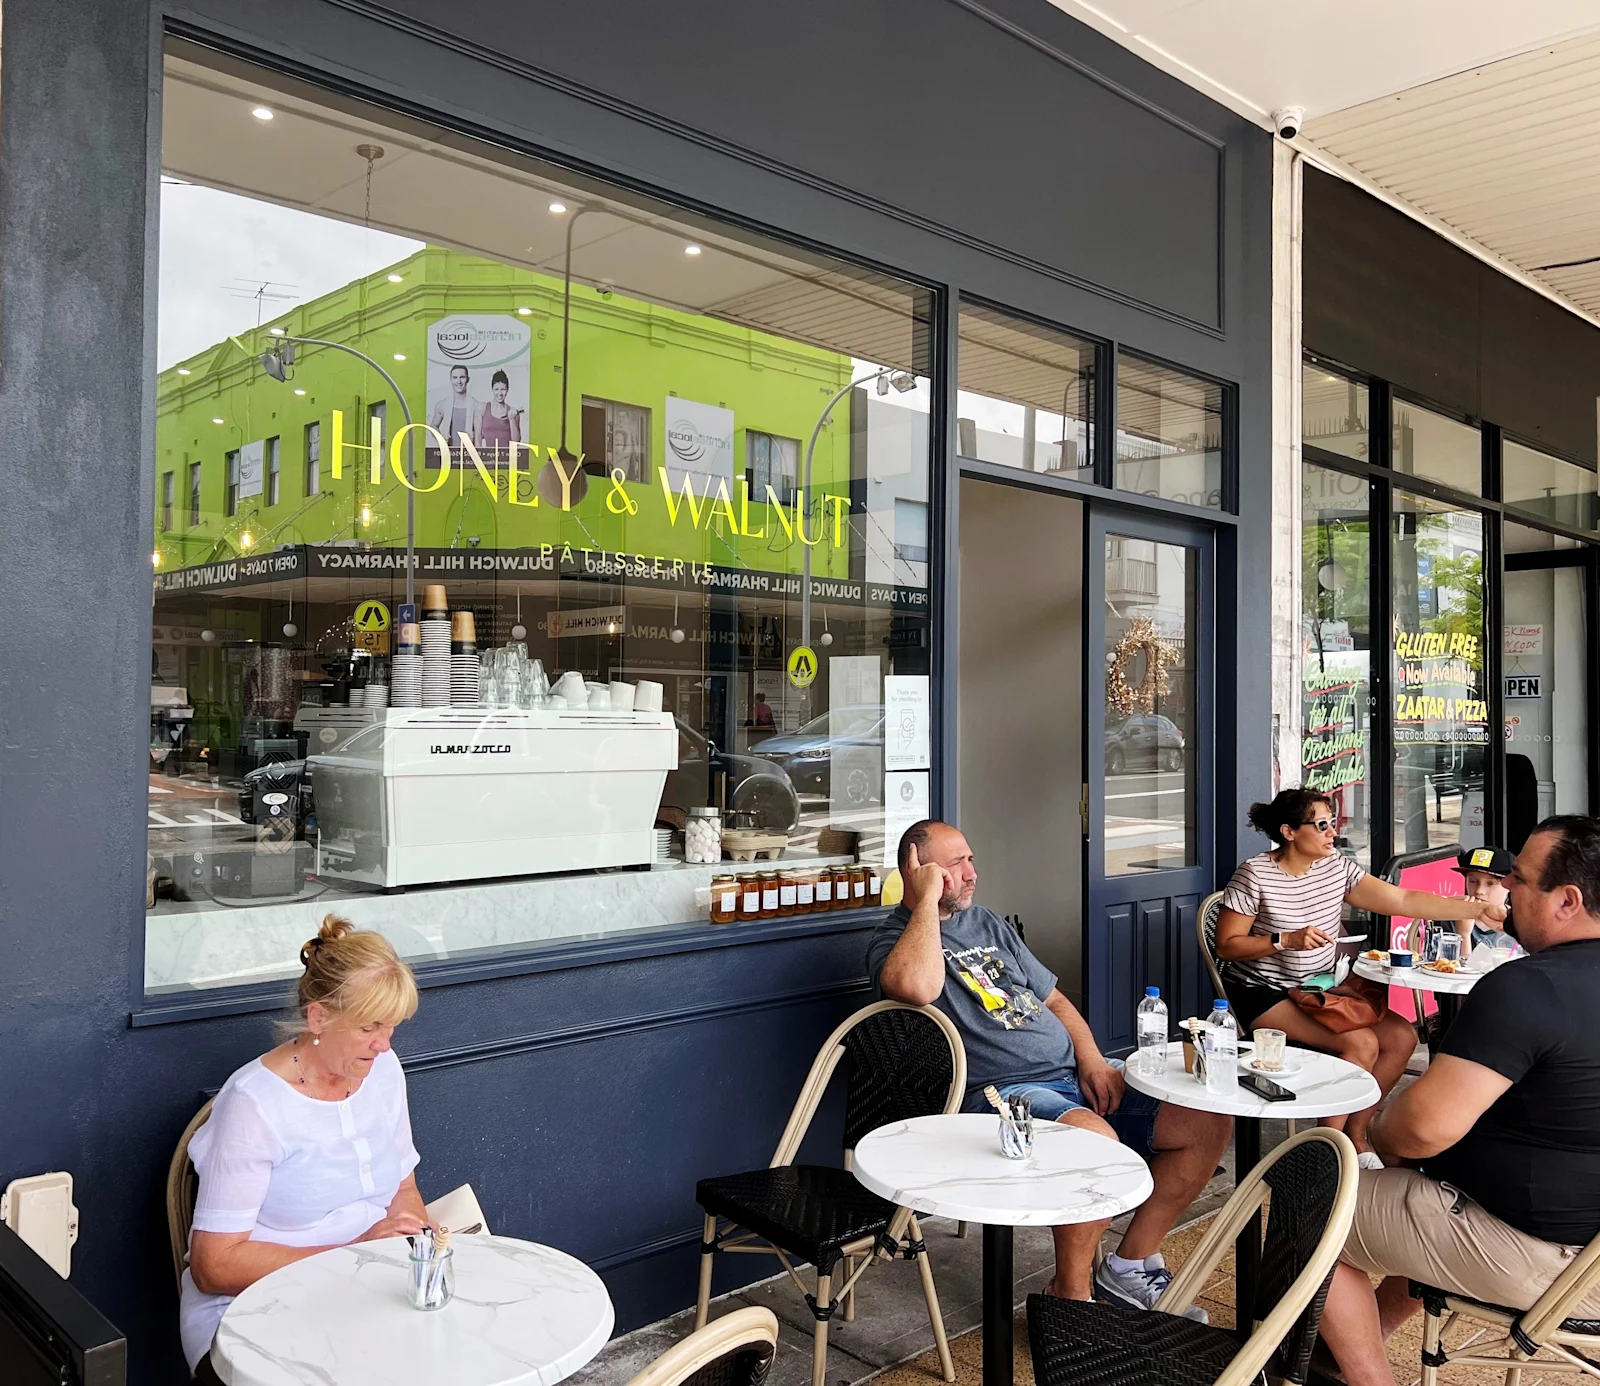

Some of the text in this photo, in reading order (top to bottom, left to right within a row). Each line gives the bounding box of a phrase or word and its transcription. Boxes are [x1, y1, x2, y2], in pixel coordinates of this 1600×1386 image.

[332, 409, 852, 548] HONEY & WALNUT
[540, 541, 714, 580] PÂTISSERIE
[1396, 631, 1478, 660] GLUTEN FREE
[1405, 660, 1476, 687] Now Available
[1505, 679, 1539, 696] PEN
[1330, 694, 1349, 724] all
[1396, 693, 1488, 722] ZAATAR & PIZZA
[1302, 730, 1365, 767] Occasions
[987, 968, 1000, 981] 23
